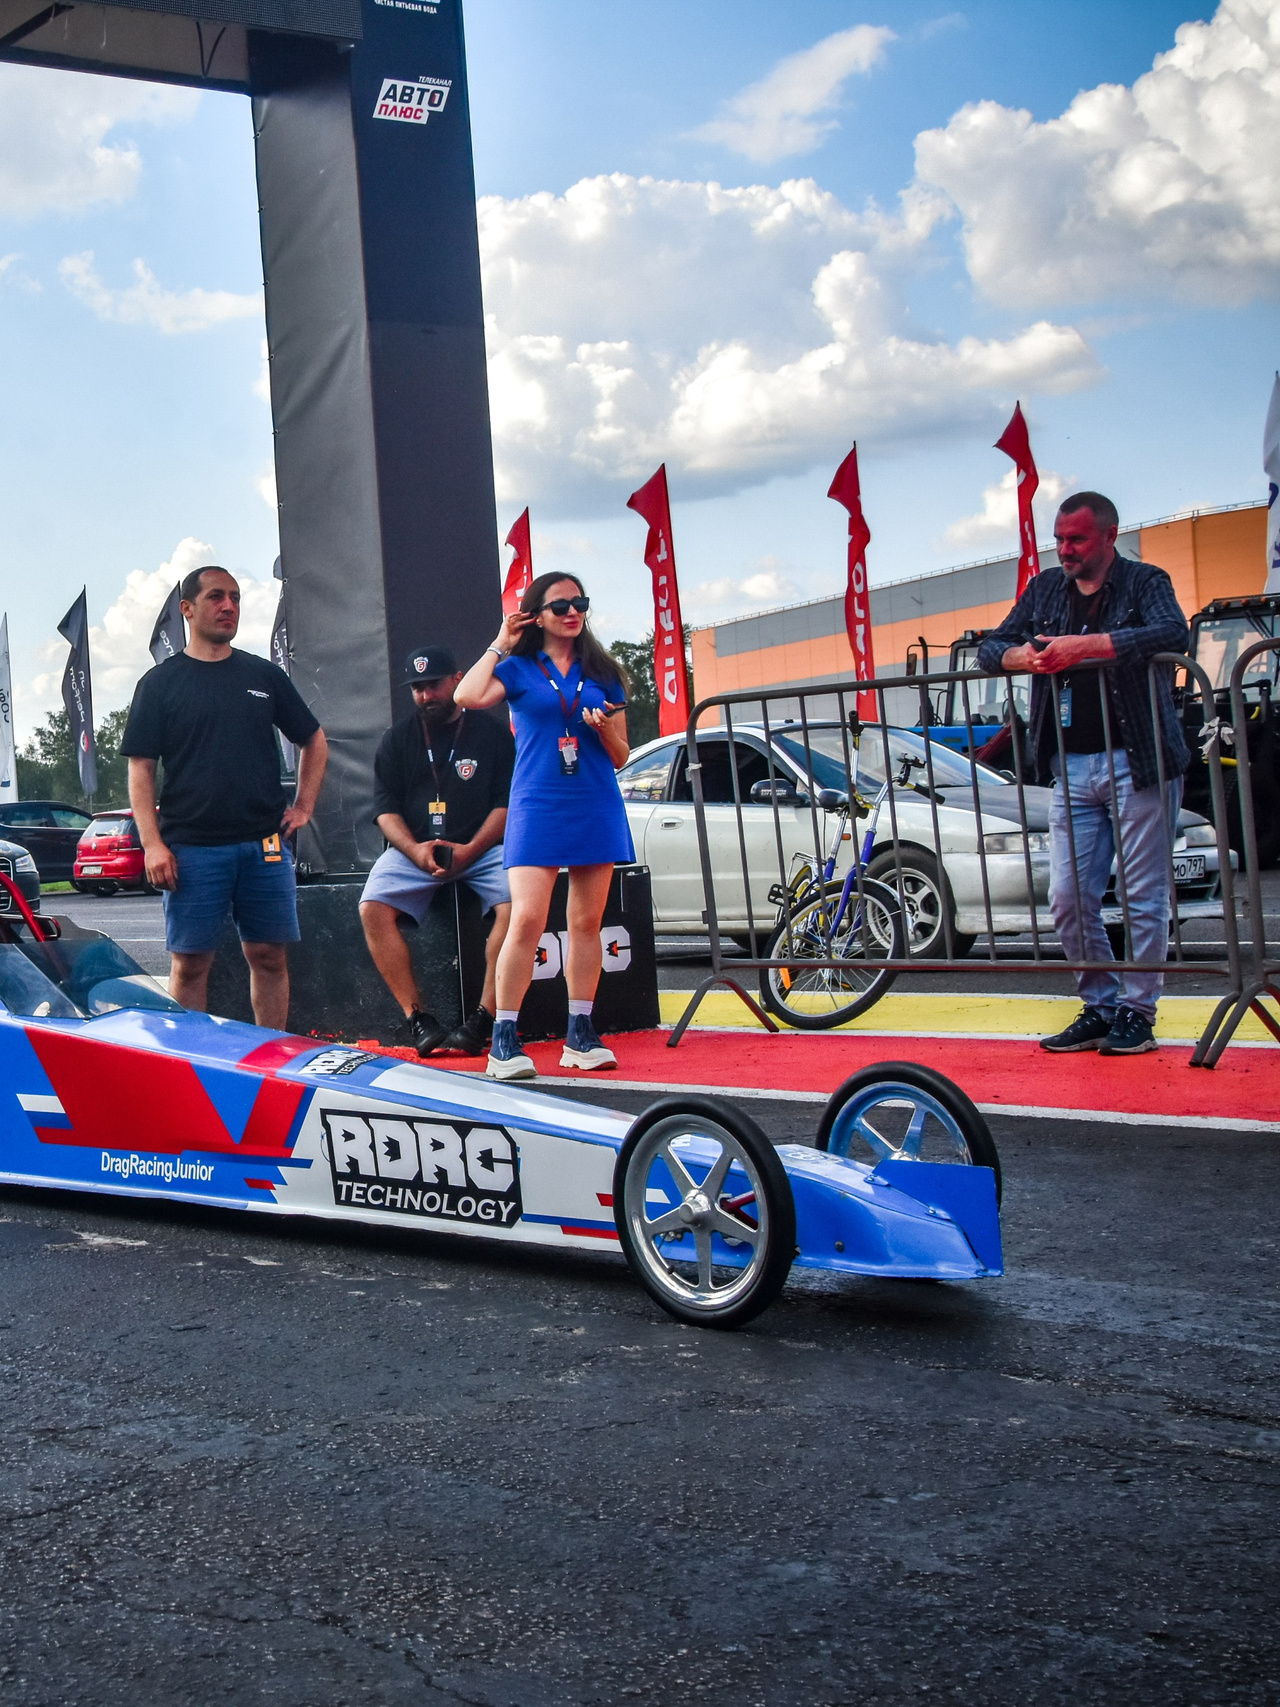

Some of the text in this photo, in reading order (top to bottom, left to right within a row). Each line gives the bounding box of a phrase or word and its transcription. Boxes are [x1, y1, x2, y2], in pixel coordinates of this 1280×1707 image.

[395, 1, 422, 11] ПИТЬЕВАЯ
[423, 5, 437, 14] ВОДА
[418, 75, 453, 86] ТЕЛЕКАНАЛ
[381, 84, 444, 107] АВТО
[378, 104, 424, 120] ПЛЮС
[1187, 858, 1202, 872] 797
[325, 1114, 516, 1192] RDRC
[100, 1151, 215, 1182] DragRacingJunior
[336, 1179, 517, 1223] TECHNOLOGY
